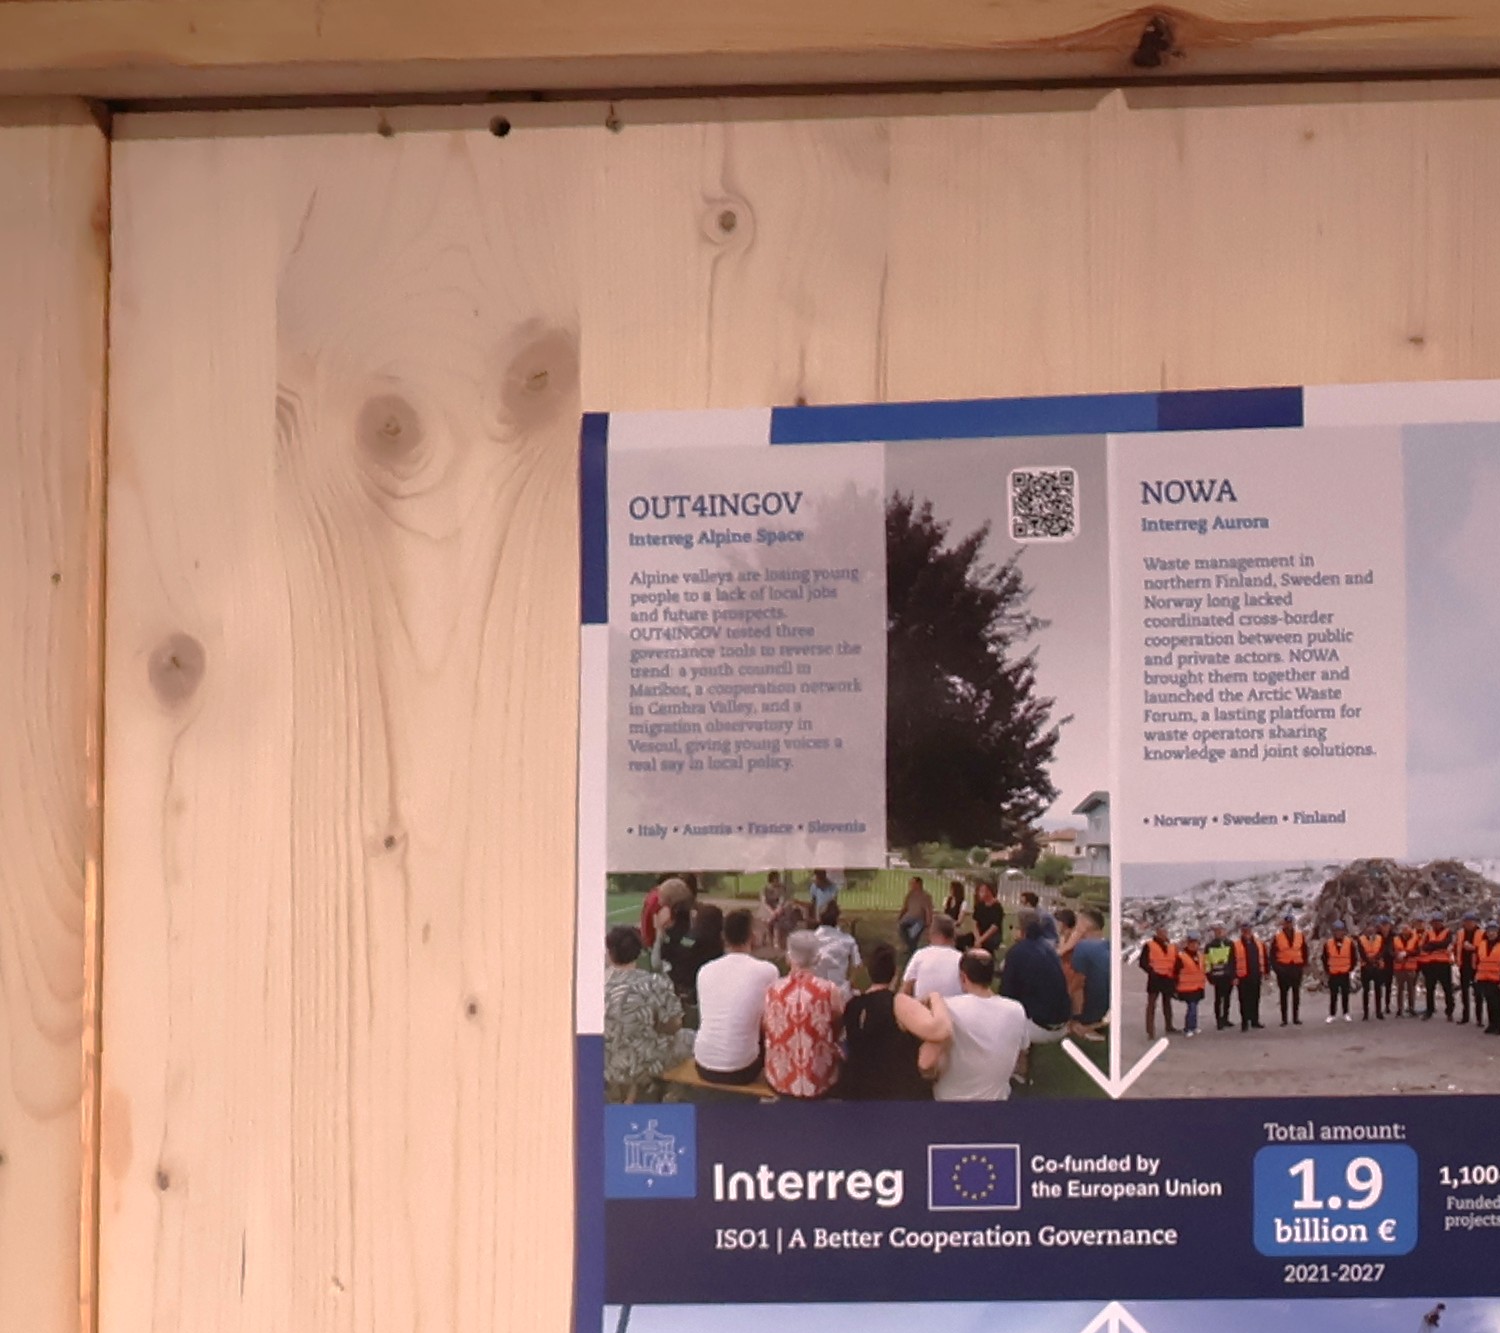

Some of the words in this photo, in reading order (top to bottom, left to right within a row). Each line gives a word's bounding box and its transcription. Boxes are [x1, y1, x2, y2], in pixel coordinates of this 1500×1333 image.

[1140, 478, 1238, 505] NOWA
[628, 490, 804, 521] OUT4INGOV
[1140, 516, 1208, 536] Interreg
[1211, 514, 1270, 531] Aurora
[1143, 594, 1203, 613] Norway
[1206, 592, 1241, 616] long
[1243, 590, 1293, 607] lacked
[1153, 813, 1208, 830] Norway
[1222, 810, 1278, 826] Sweden
[1292, 808, 1346, 825] Finland
[1263, 1120, 1315, 1141] Total
[1319, 1122, 1406, 1141] amount:
[1030, 1154, 1131, 1173] Co-funded
[1136, 1153, 1160, 1176] by
[713, 1163, 903, 1207] Interreg
[1030, 1180, 1062, 1198] the
[1067, 1179, 1160, 1201] European
[1164, 1178, 1222, 1197] Union
[1288, 1156, 1383, 1210] 1.9
[715, 1228, 769, 1250] ISO1
[787, 1228, 807, 1249] A
[813, 1227, 883, 1248] Better
[888, 1224, 1032, 1253] Cooperation
[1037, 1225, 1178, 1246] Governance
[1273, 1216, 1368, 1243] billion
[1377, 1218, 1397, 1242] €
[1283, 1262, 1385, 1283] 2021-2027
